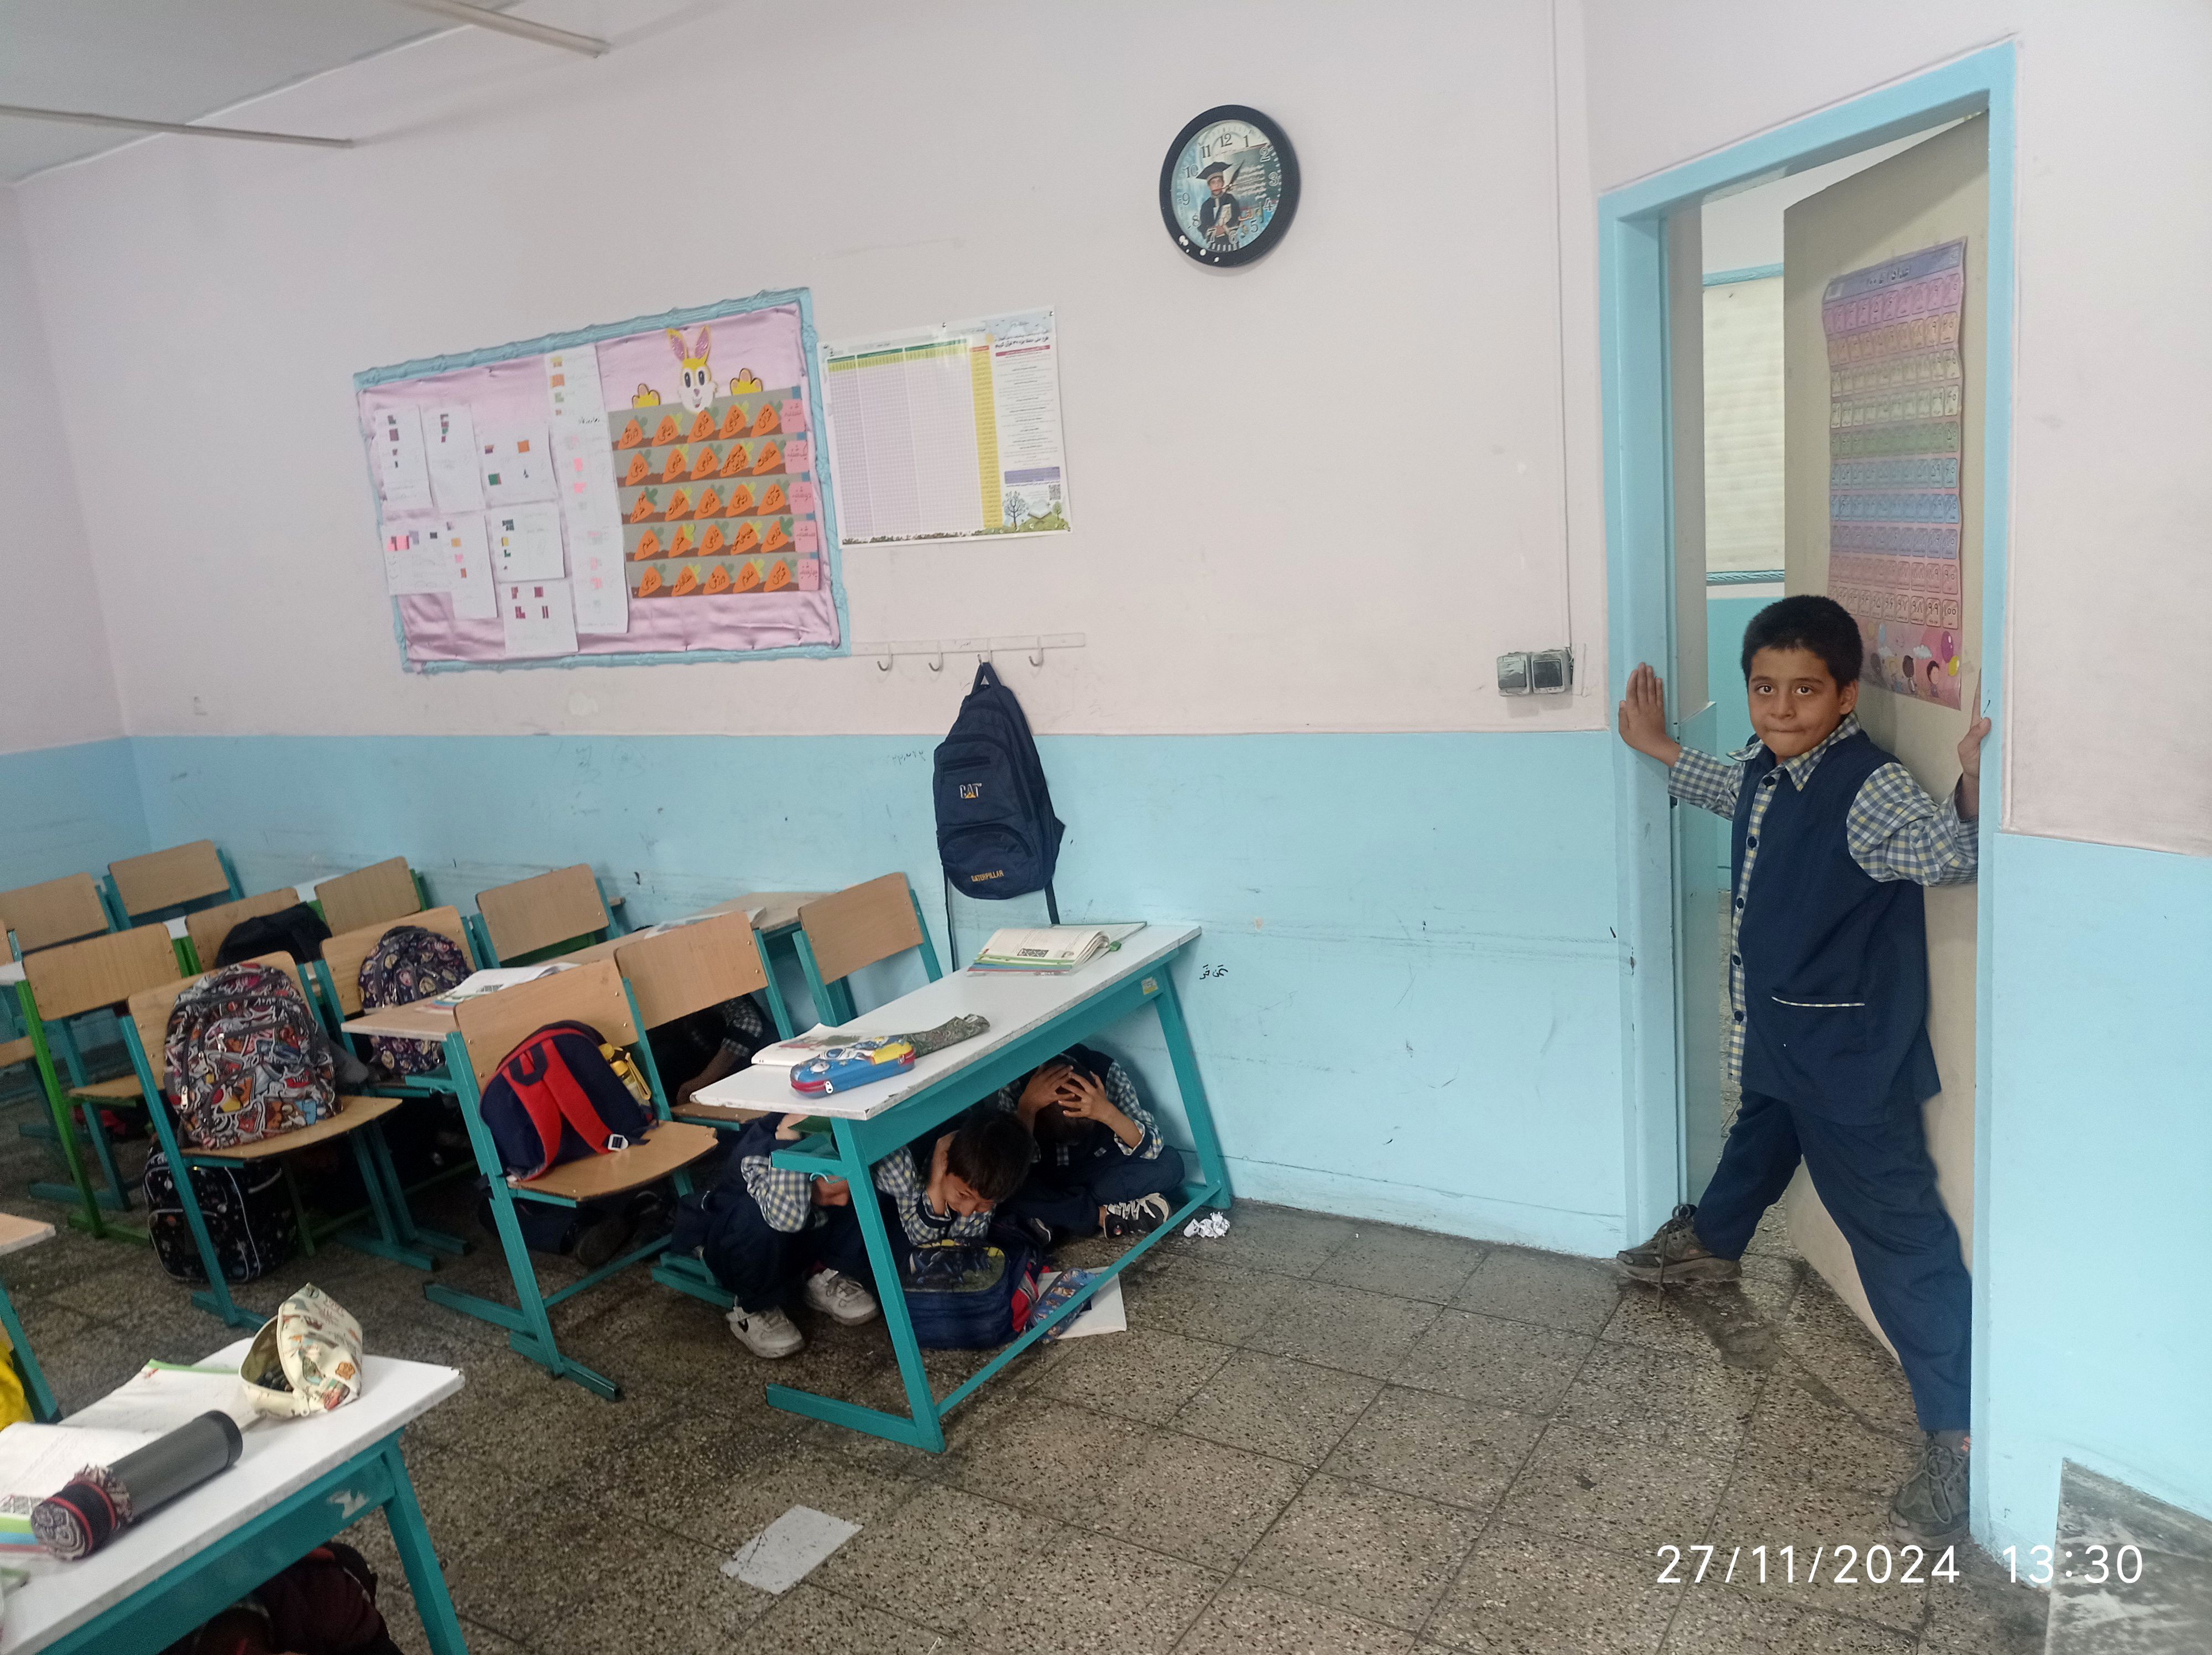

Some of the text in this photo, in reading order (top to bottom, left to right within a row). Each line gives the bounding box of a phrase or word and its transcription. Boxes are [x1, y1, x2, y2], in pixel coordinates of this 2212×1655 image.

[1218, 133, 1233, 148] 12
[1243, 135, 1249, 148] 1
[1201, 144, 1212, 159] 11
[1259, 147, 1271, 163] 2
[1183, 164, 1199, 179] 10
[1268, 172, 1279, 187] 3
[1182, 192, 1191, 206] 9
[1263, 197, 1274, 212] 4
[1192, 212, 1201, 227] 8
[1250, 219, 1259, 233] 5
[1207, 227, 1217, 244] 7
[1229, 229, 1238, 244] 6
[694, 414, 709, 438] فارسی
[726, 409, 740, 433] فارسی
[658, 424, 674, 441] ریاضی
[668, 454, 681, 473] فارسی
[697, 451, 713, 472] فارسی
[700, 493, 716, 514] فارسی
[706, 529, 719, 549] فارسی
[767, 527, 781, 545] فارسی
[1912, 600, 1923, 613] ۹۸
[1928, 602, 1939, 616] ۹۹
[1943, 604, 1957, 617] ۱۰۰
[959, 783, 981, 799] CAT
[971, 870, 1004, 882] CATERPILLAR
